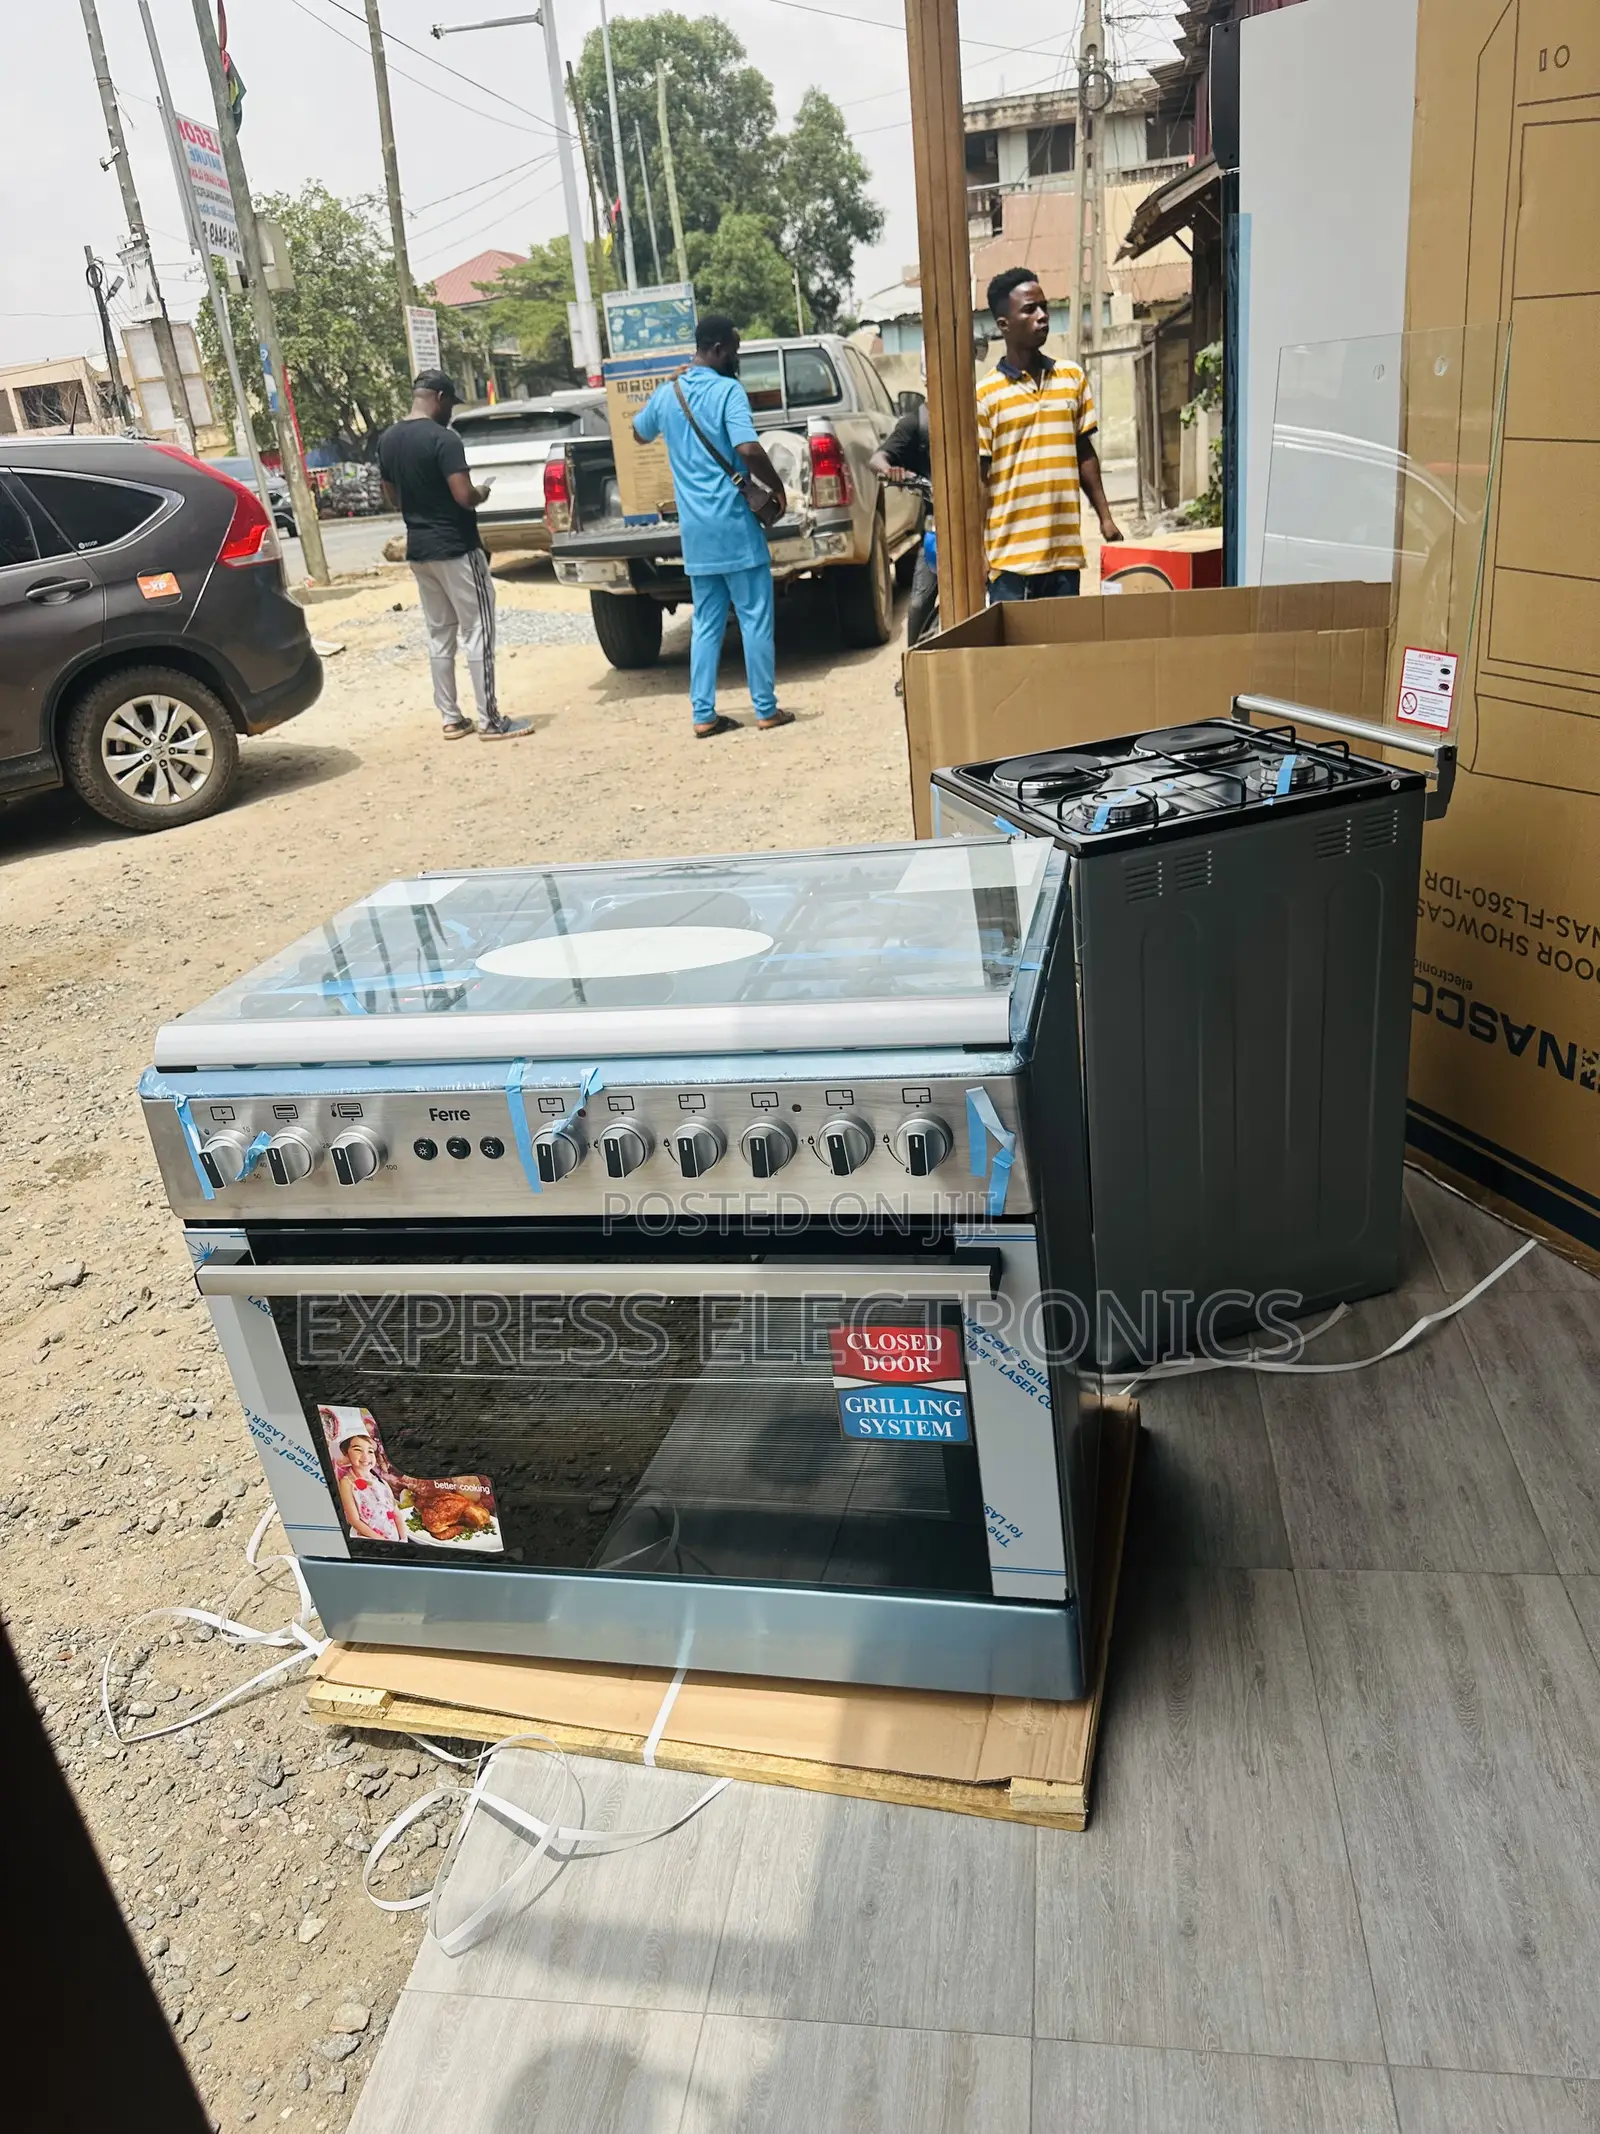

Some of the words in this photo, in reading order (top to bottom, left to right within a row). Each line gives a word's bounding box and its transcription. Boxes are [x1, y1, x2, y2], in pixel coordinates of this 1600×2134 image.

[1537, 941, 1600, 984] OOR
[429, 1108, 471, 1121] Ferre
[846, 1332, 942, 1351] CLOSED
[861, 1354, 933, 1373] DOOR
[998, 1364, 1038, 1397] LASER
[844, 1396, 962, 1417] GRILLING
[252, 1415, 286, 1442] LASER
[858, 1417, 953, 1438] SYSTEM
[433, 1480, 457, 1490] better
[459, 1483, 490, 1495] cooking
[987, 1525, 1010, 1548] The
[1004, 1523, 1024, 1538] for
